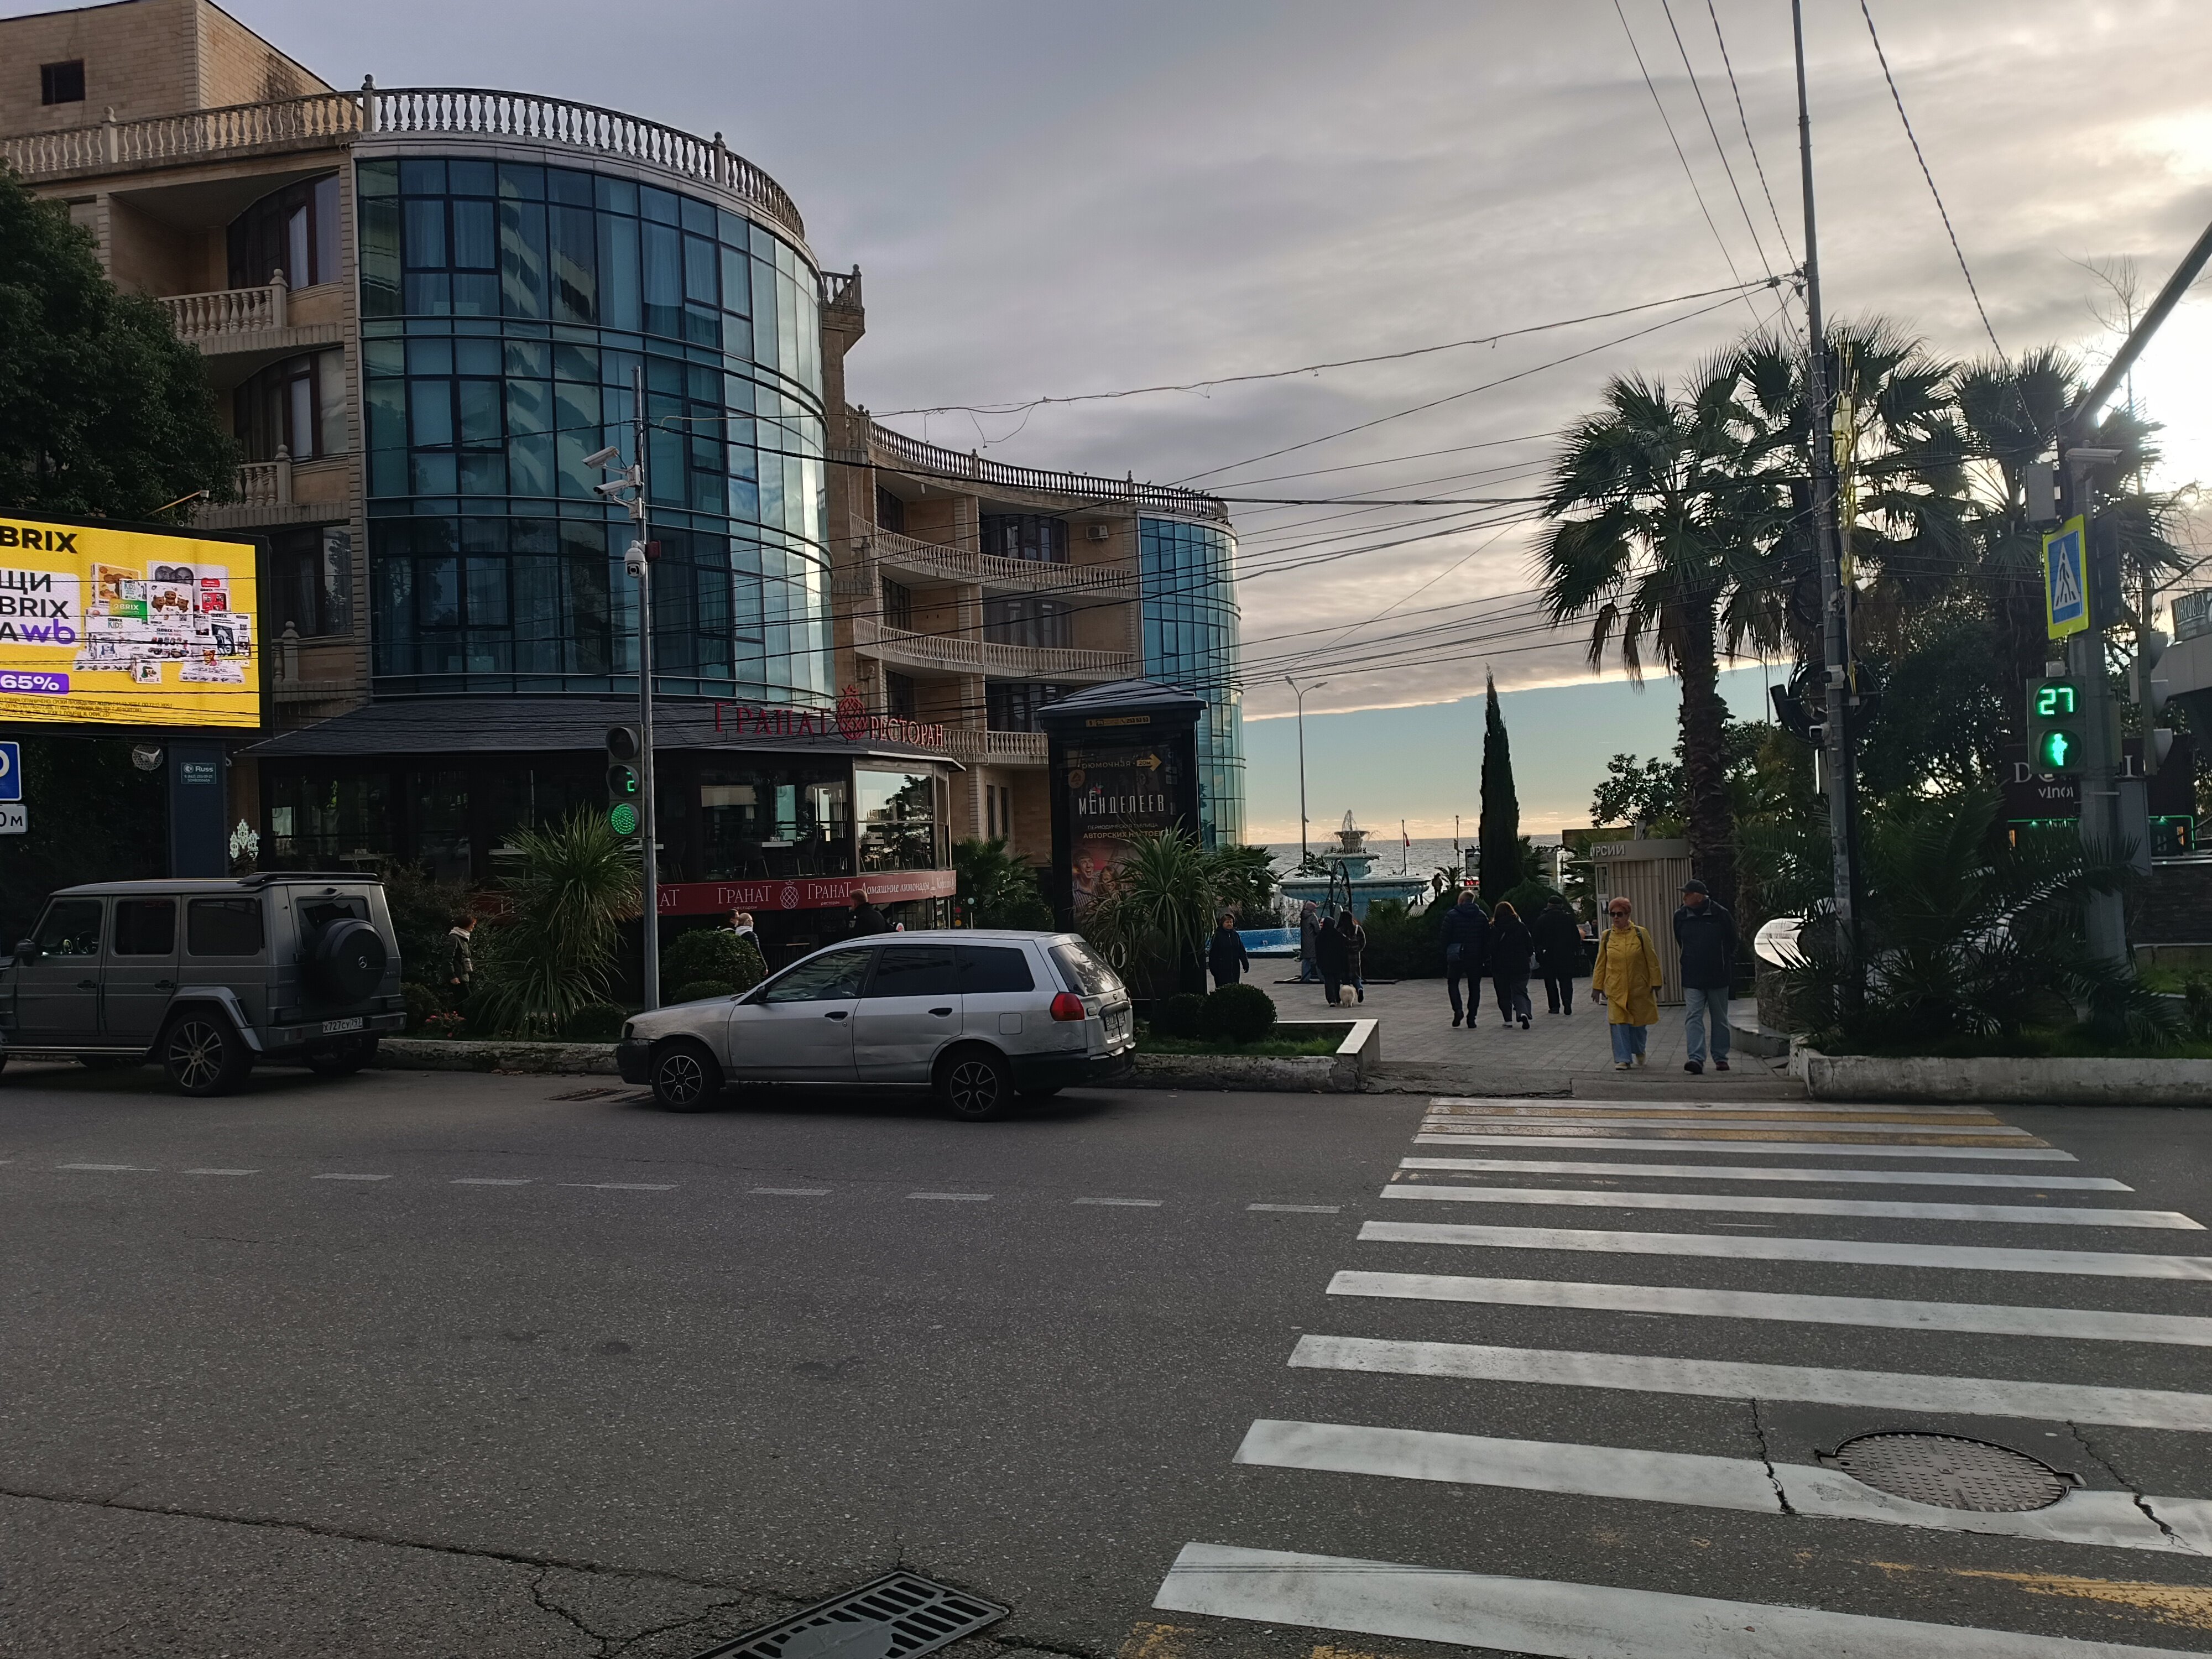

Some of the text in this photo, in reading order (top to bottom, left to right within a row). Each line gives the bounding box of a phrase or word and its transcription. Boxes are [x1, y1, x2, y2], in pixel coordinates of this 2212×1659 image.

[2174, 592, 2205, 621] ПАРОВОЗ
[2039, 688, 2073, 715] 27
[714, 701, 943, 747] ГРАНАТ РЕСТОРАН
[1082, 760, 1131, 770] рюмочная
[717, 885, 772, 904] ГРАНАТ
[807, 881, 852, 900] ГРАНАТ
